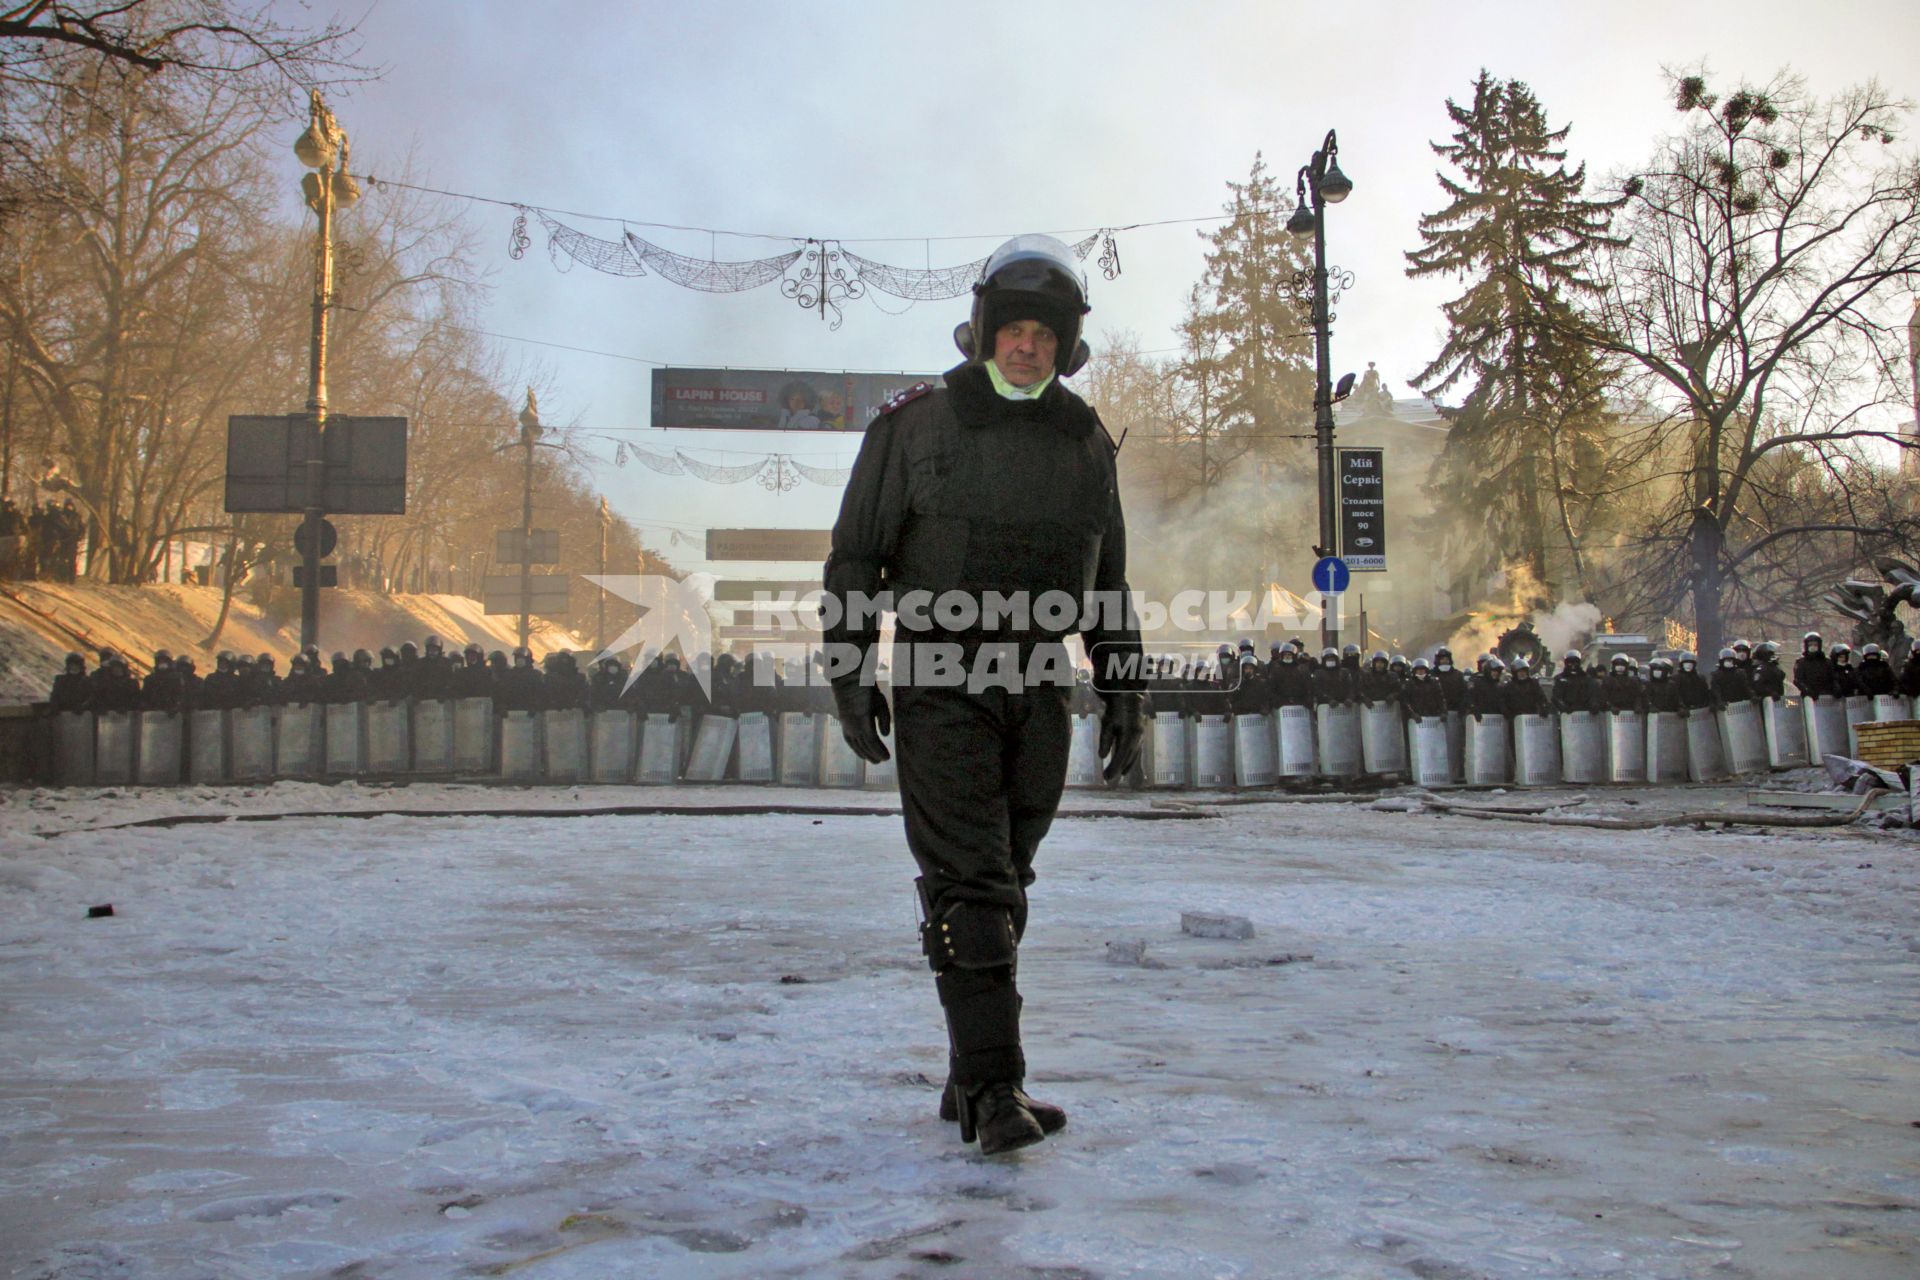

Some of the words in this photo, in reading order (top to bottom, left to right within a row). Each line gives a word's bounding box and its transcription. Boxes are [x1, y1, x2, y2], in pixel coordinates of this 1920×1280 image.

[675, 389, 714, 400] LAPIN
[719, 390, 763, 402] HOUSE
[1350, 459, 1372, 468] Мій
[1343, 475, 1381, 486] Сервіс
[1346, 558, 1384, 566] 201-6000
